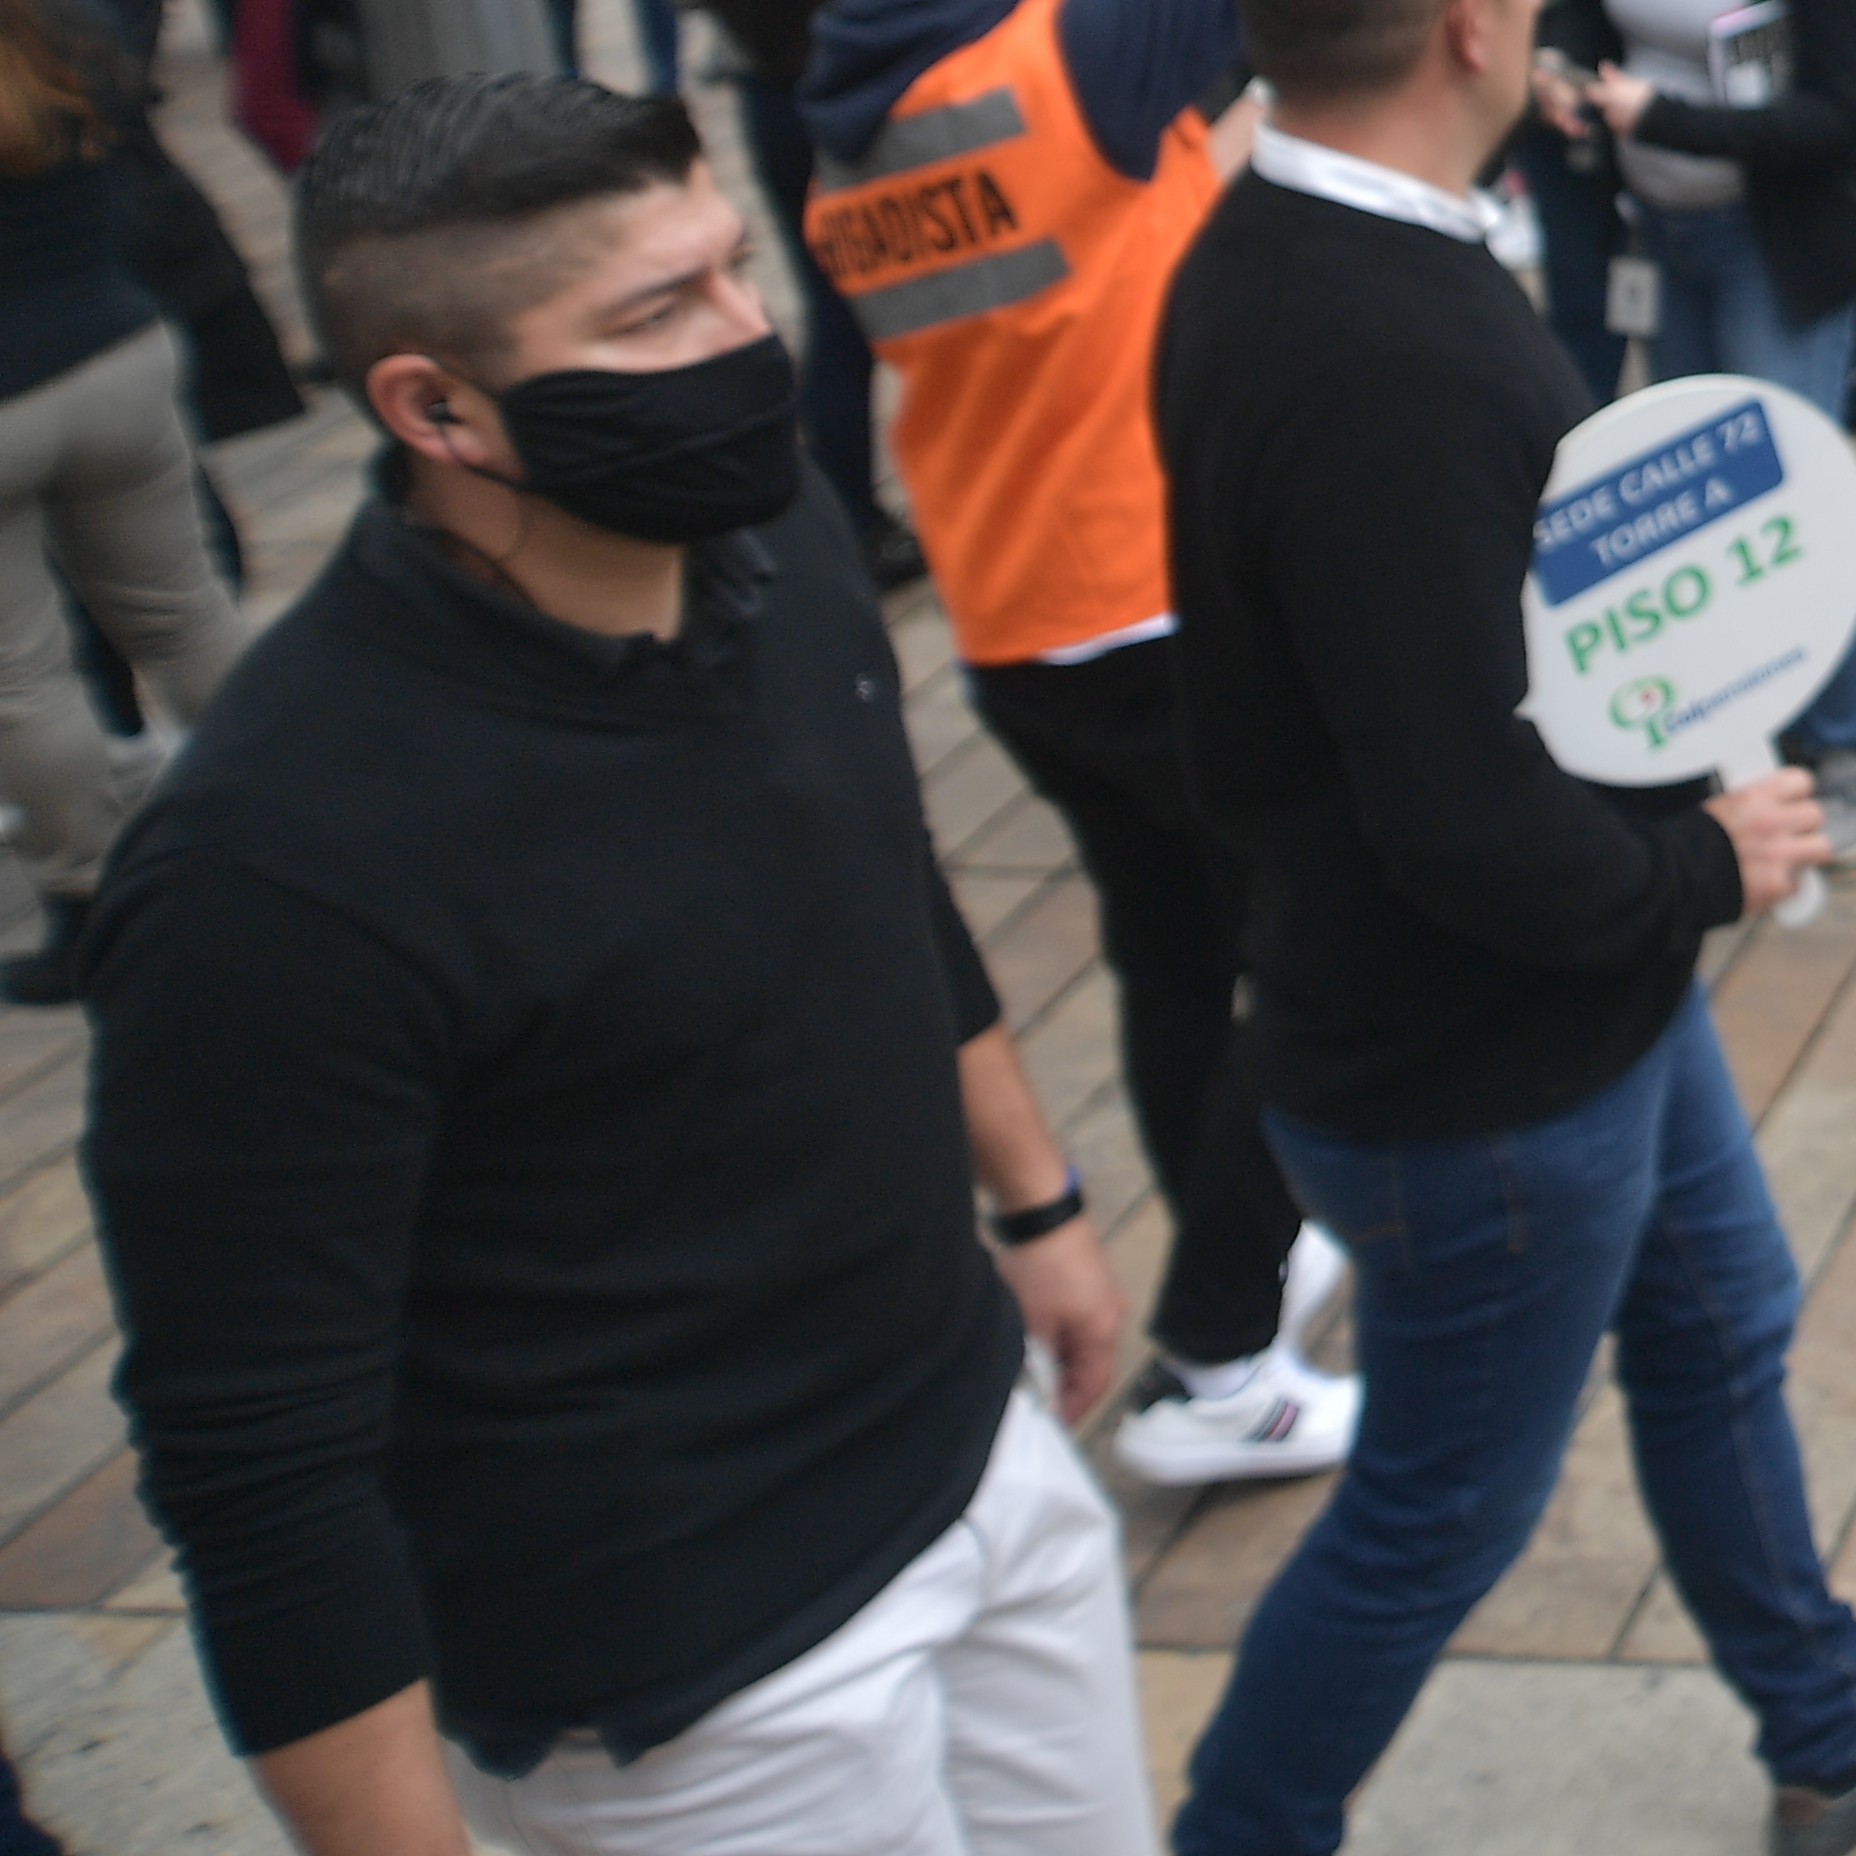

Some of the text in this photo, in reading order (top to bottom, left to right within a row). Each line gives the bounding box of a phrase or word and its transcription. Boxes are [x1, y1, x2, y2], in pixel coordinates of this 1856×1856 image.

[1618, 434, 1716, 505] CALLE
[1715, 412, 1761, 453] 72
[1590, 477, 1733, 566] TORRE A
[1563, 515, 1802, 674] PISO 12
